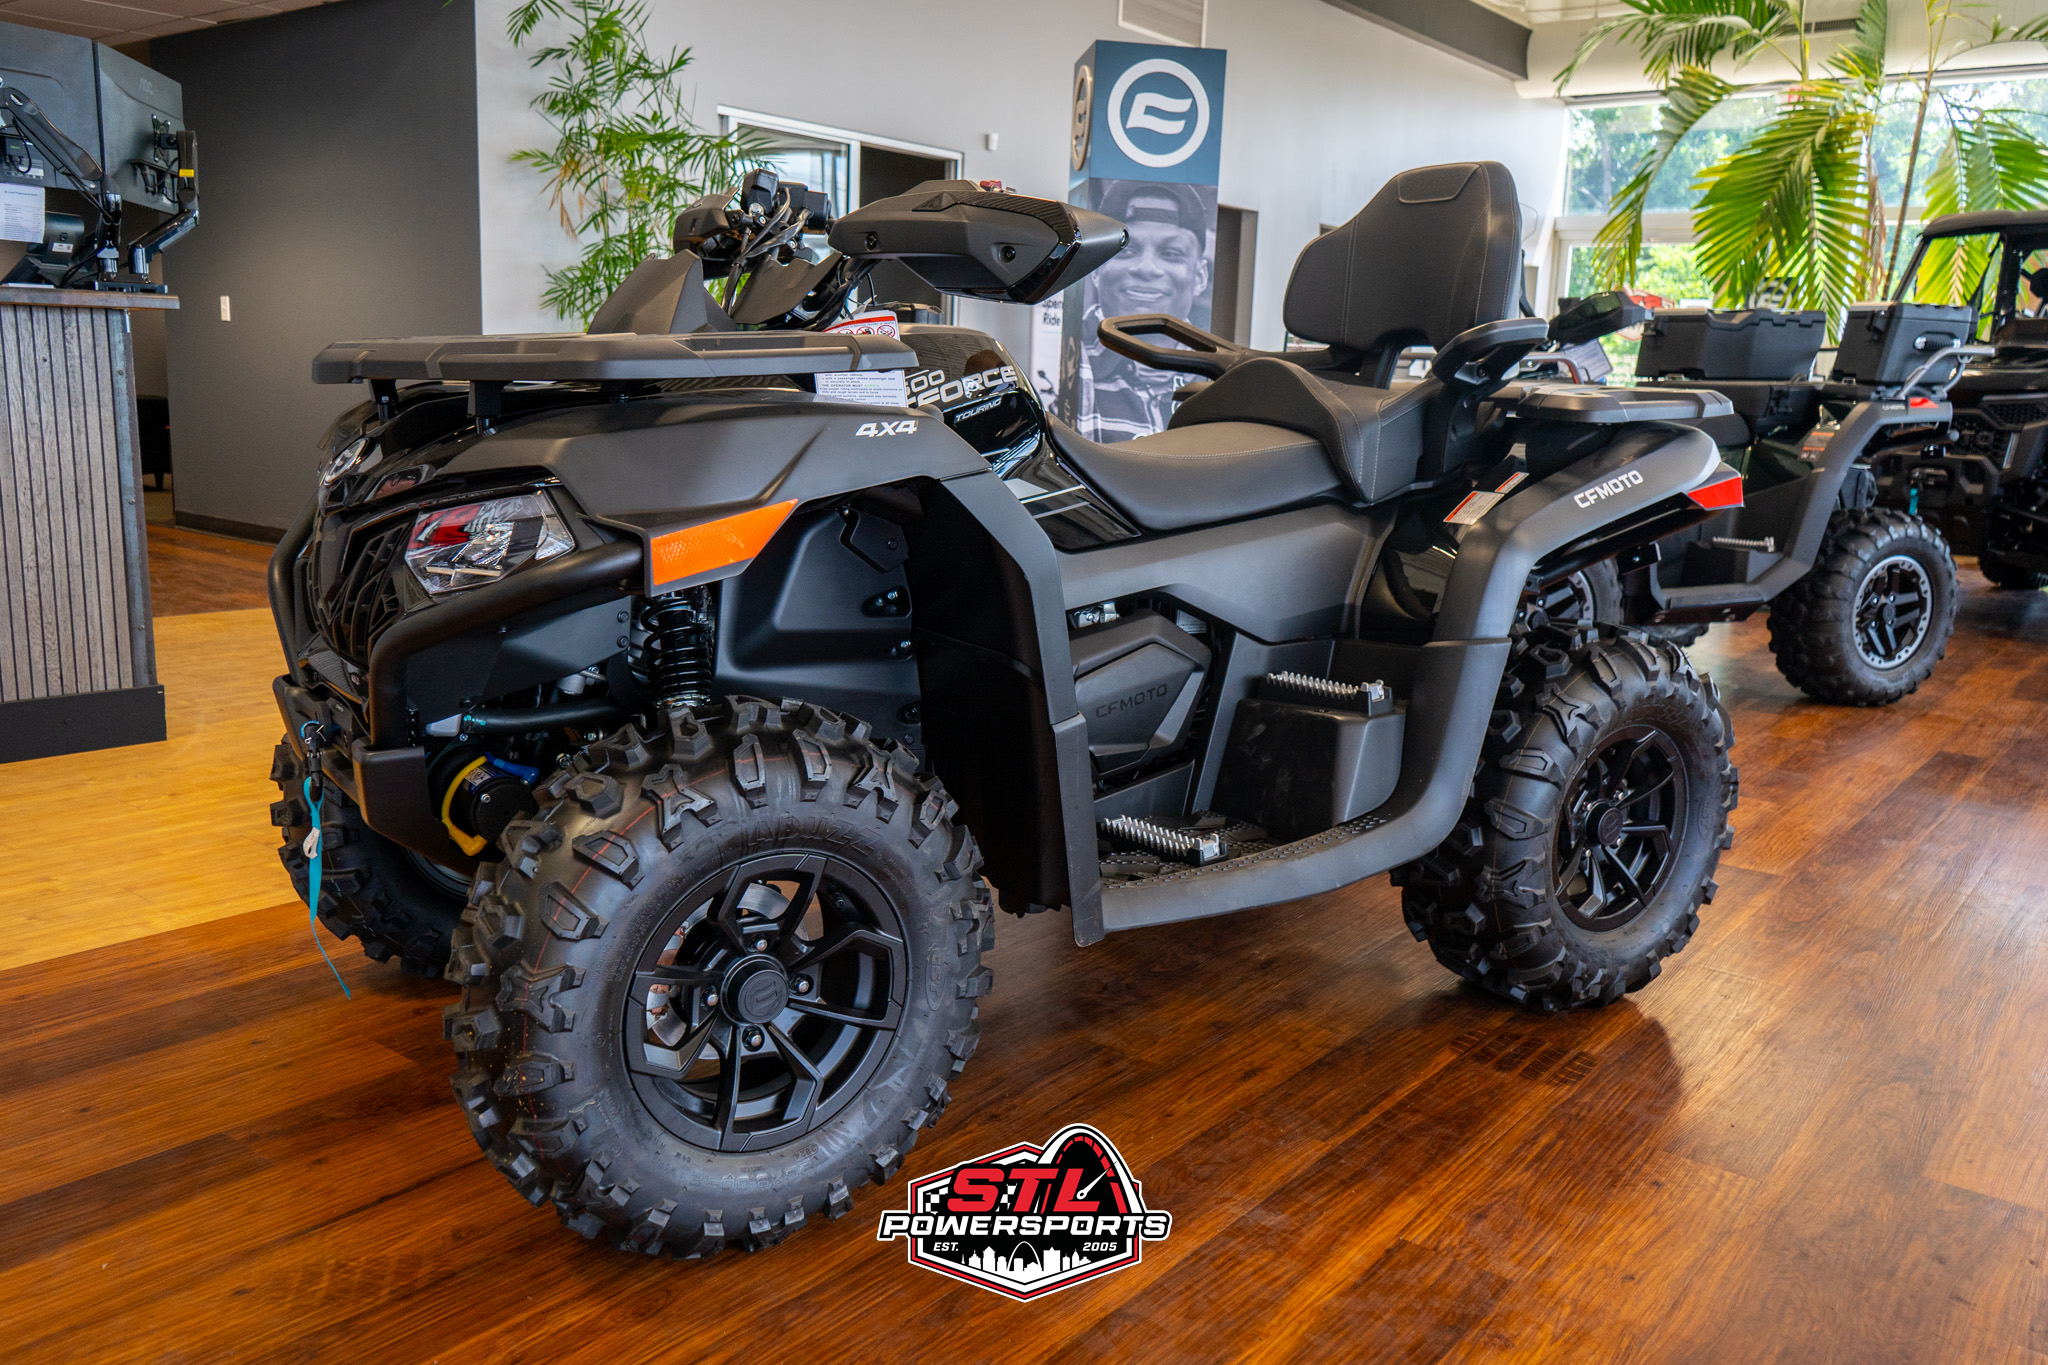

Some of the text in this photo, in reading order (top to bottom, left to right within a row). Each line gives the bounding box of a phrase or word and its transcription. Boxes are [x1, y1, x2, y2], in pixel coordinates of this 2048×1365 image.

[954, 398, 1002, 423] TOURING
[1573, 469, 1644, 509] CFMOTO
[1095, 683, 1168, 718] CFMOTO
